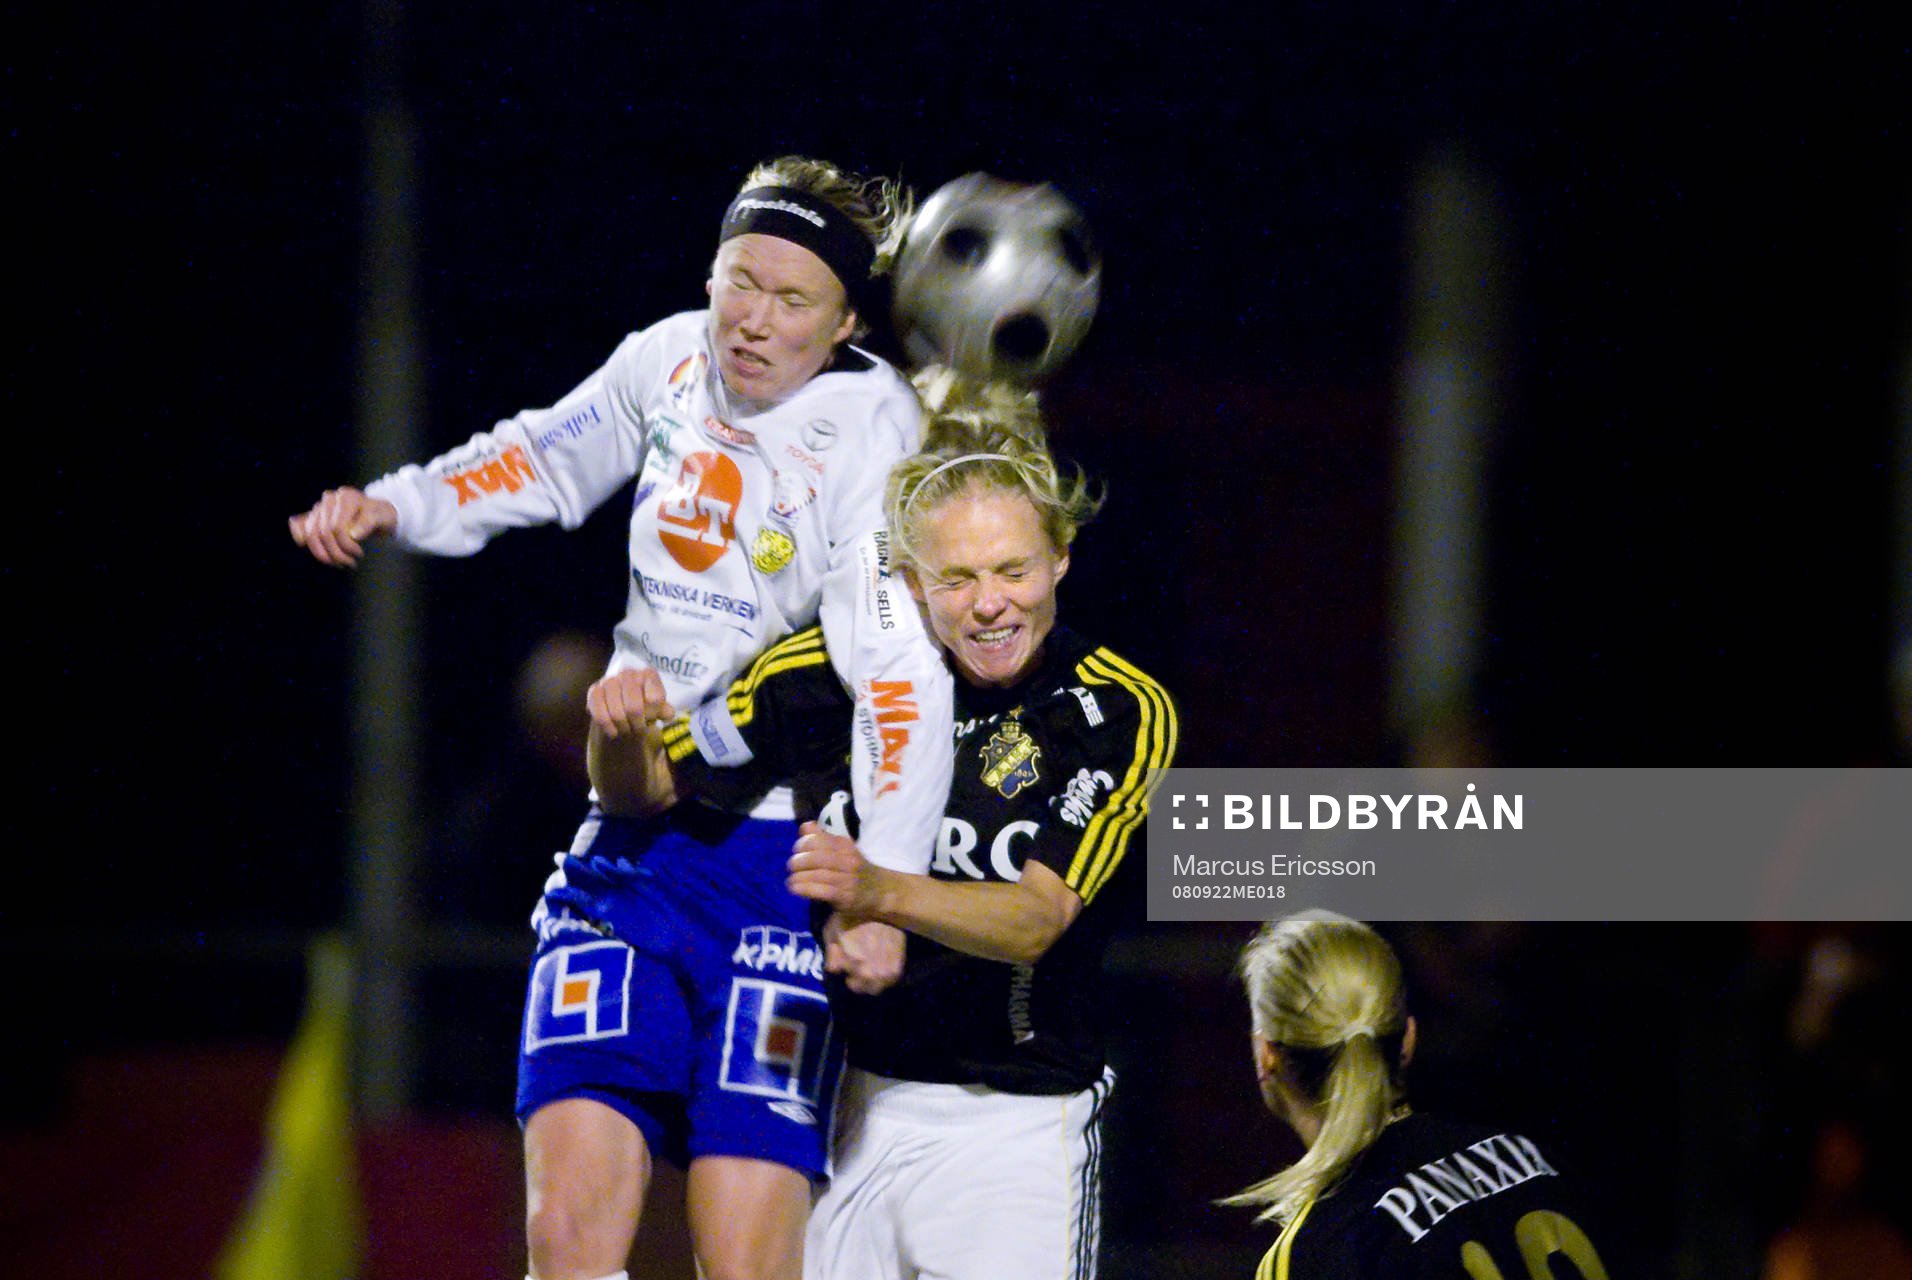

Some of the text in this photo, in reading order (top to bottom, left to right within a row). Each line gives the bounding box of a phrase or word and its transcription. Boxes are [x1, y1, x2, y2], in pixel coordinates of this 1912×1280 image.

[656, 470, 733, 548] BT
[643, 576, 698, 603] TEKNISKA
[703, 591, 757, 622] VERKEN
[877, 590, 895, 630] SELLS
